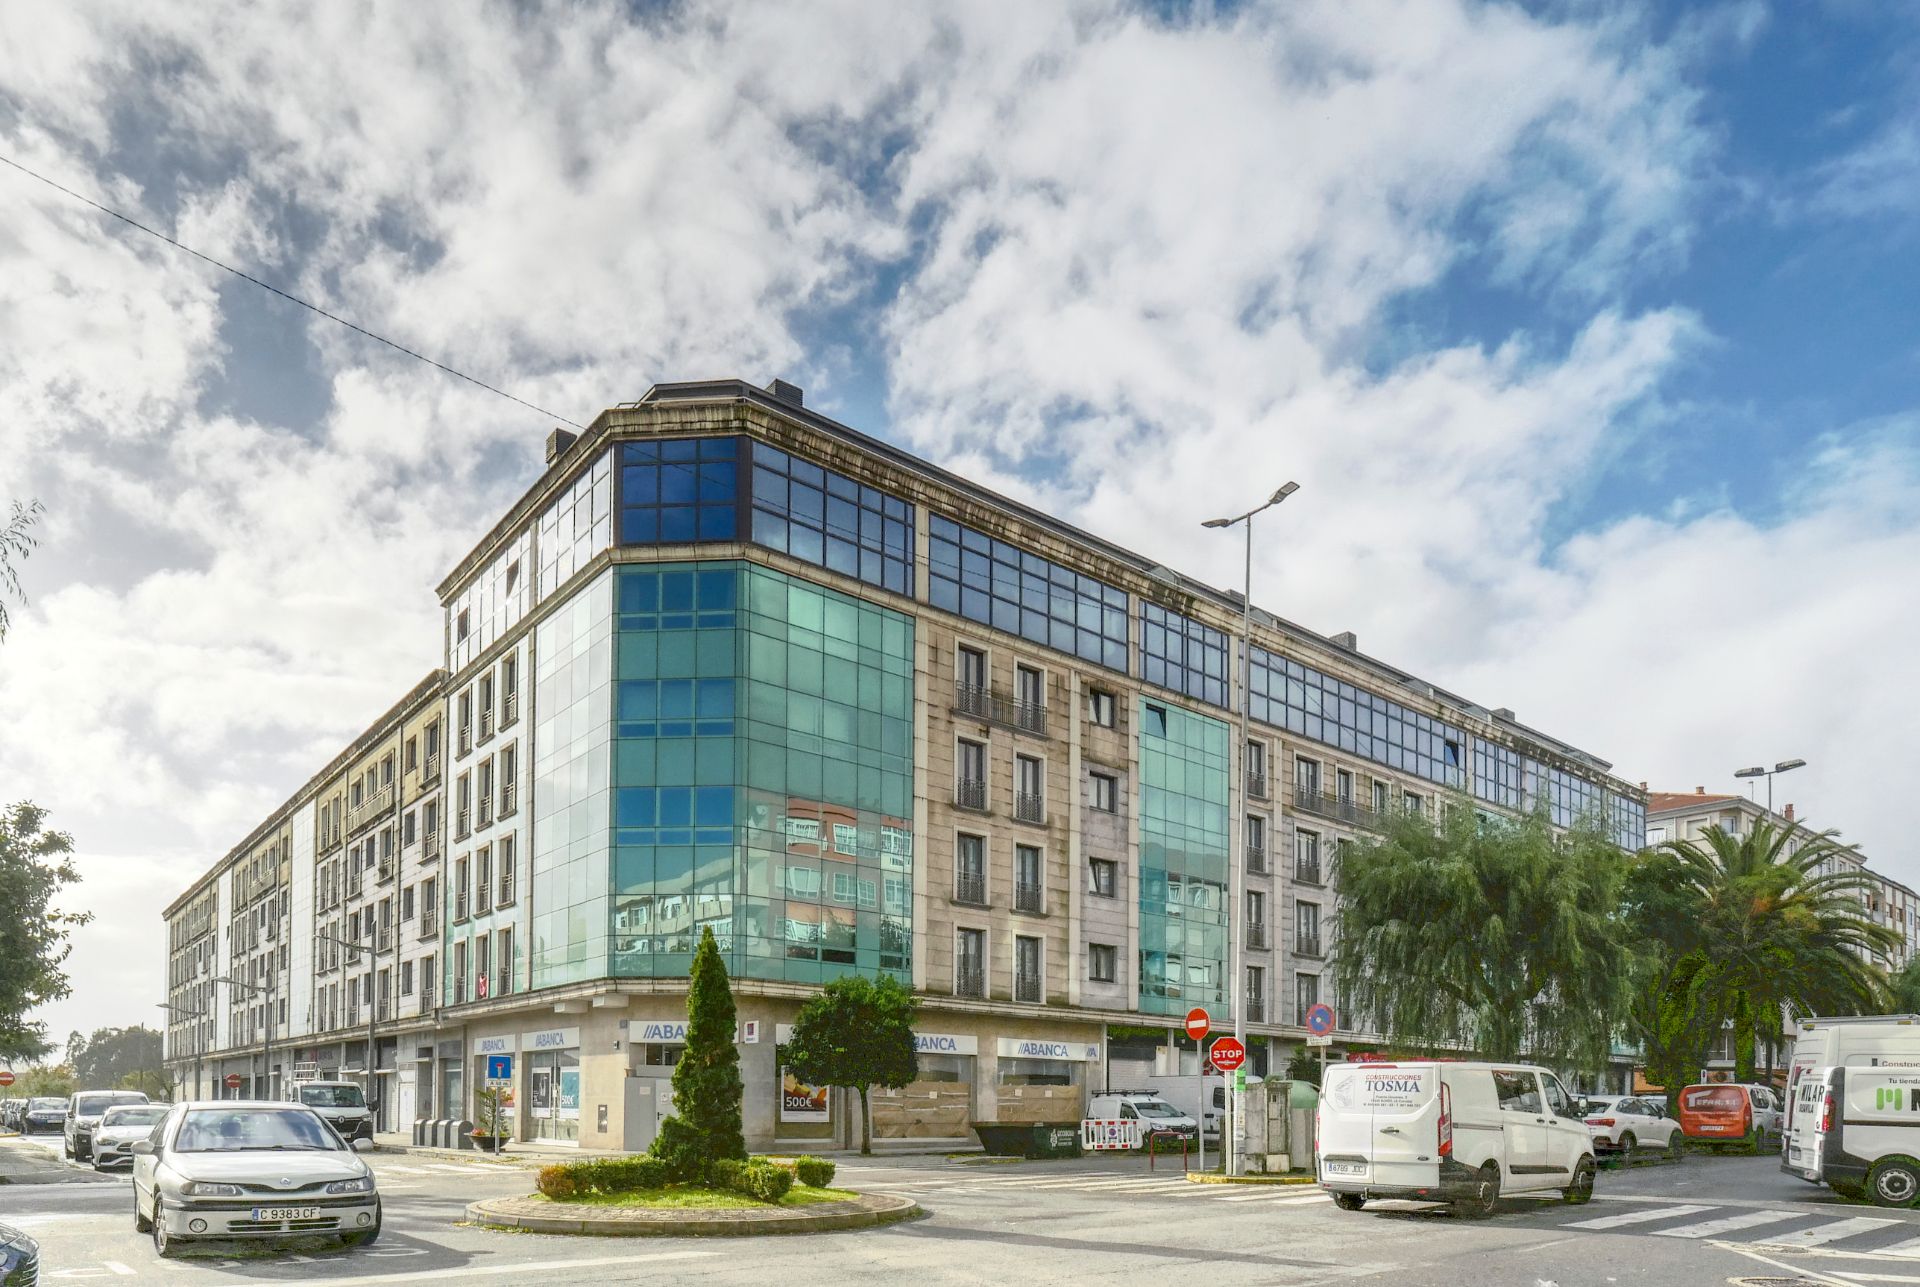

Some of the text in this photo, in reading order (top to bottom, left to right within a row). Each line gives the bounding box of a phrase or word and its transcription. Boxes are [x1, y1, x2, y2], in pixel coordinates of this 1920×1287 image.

[1213, 1049, 1243, 1059] STOP
[1365, 1080, 1421, 1093] TOSMA
[1800, 1084, 1826, 1103] MILAR
[786, 1096, 813, 1107] 500€
[260, 1208, 317, 1220] C 9383 CF
